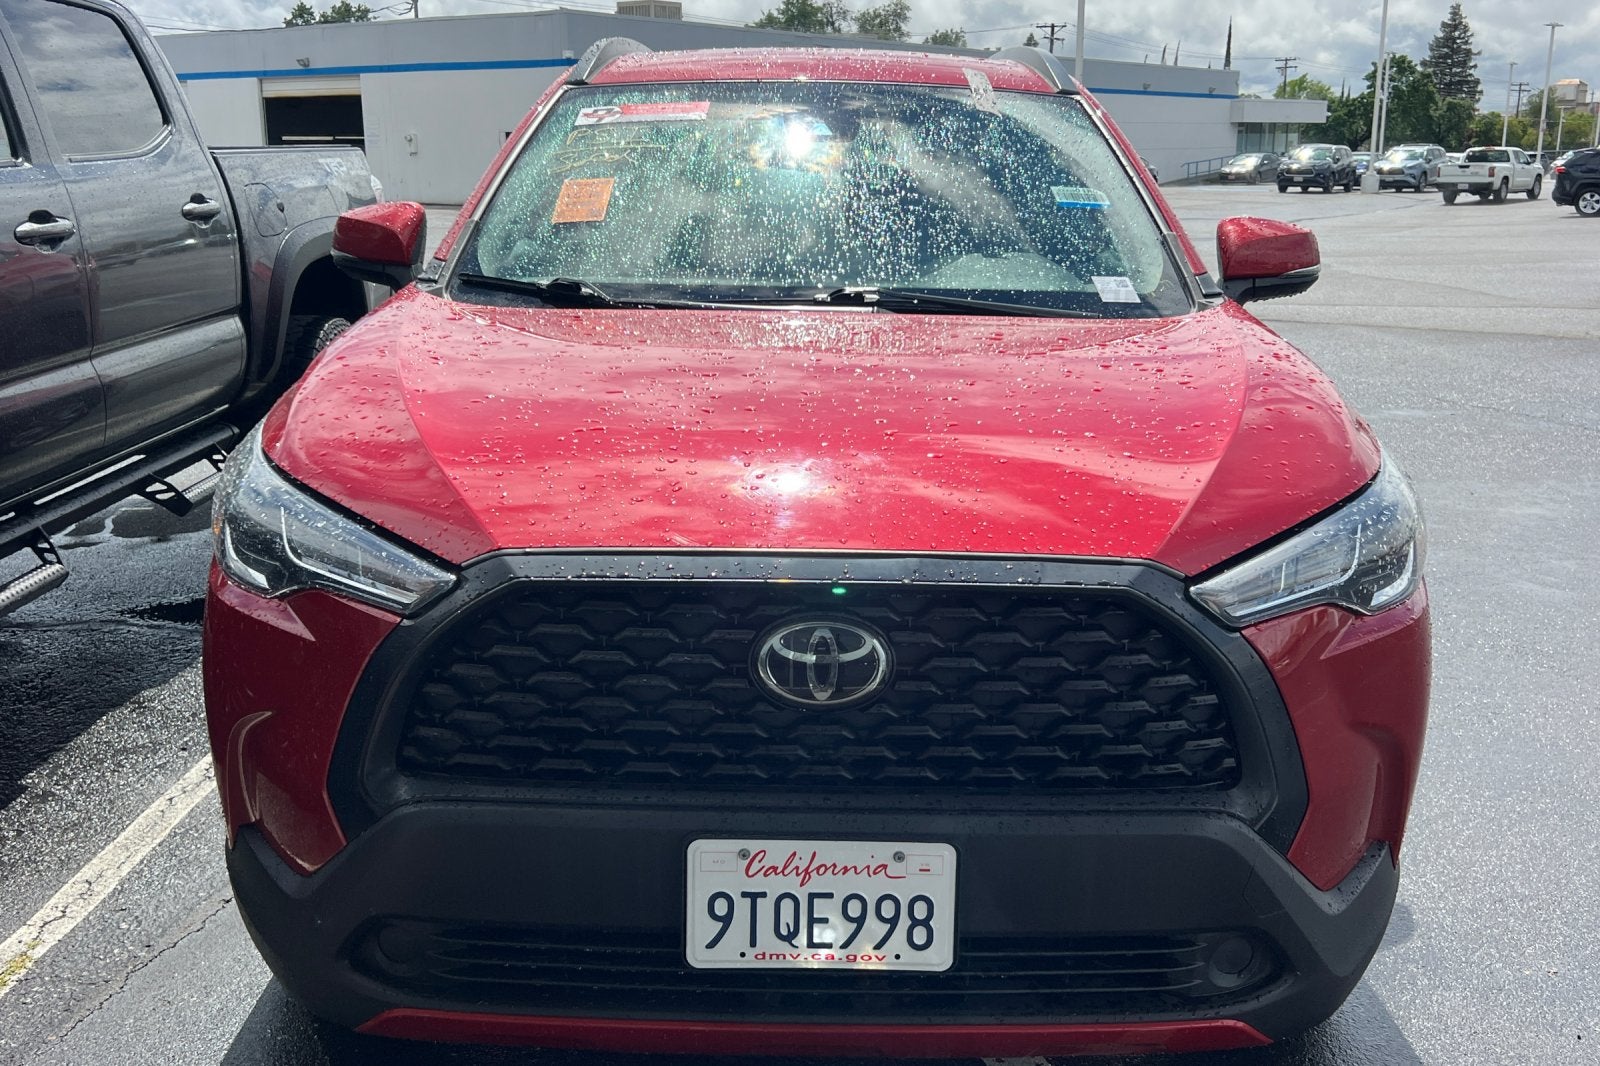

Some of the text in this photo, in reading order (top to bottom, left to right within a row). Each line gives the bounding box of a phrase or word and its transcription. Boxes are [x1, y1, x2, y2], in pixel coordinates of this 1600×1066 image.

[744, 850, 906, 887] California
[705, 891, 934, 951] 9TQE998
[754, 952, 888, 963] dmv.ca.gov
